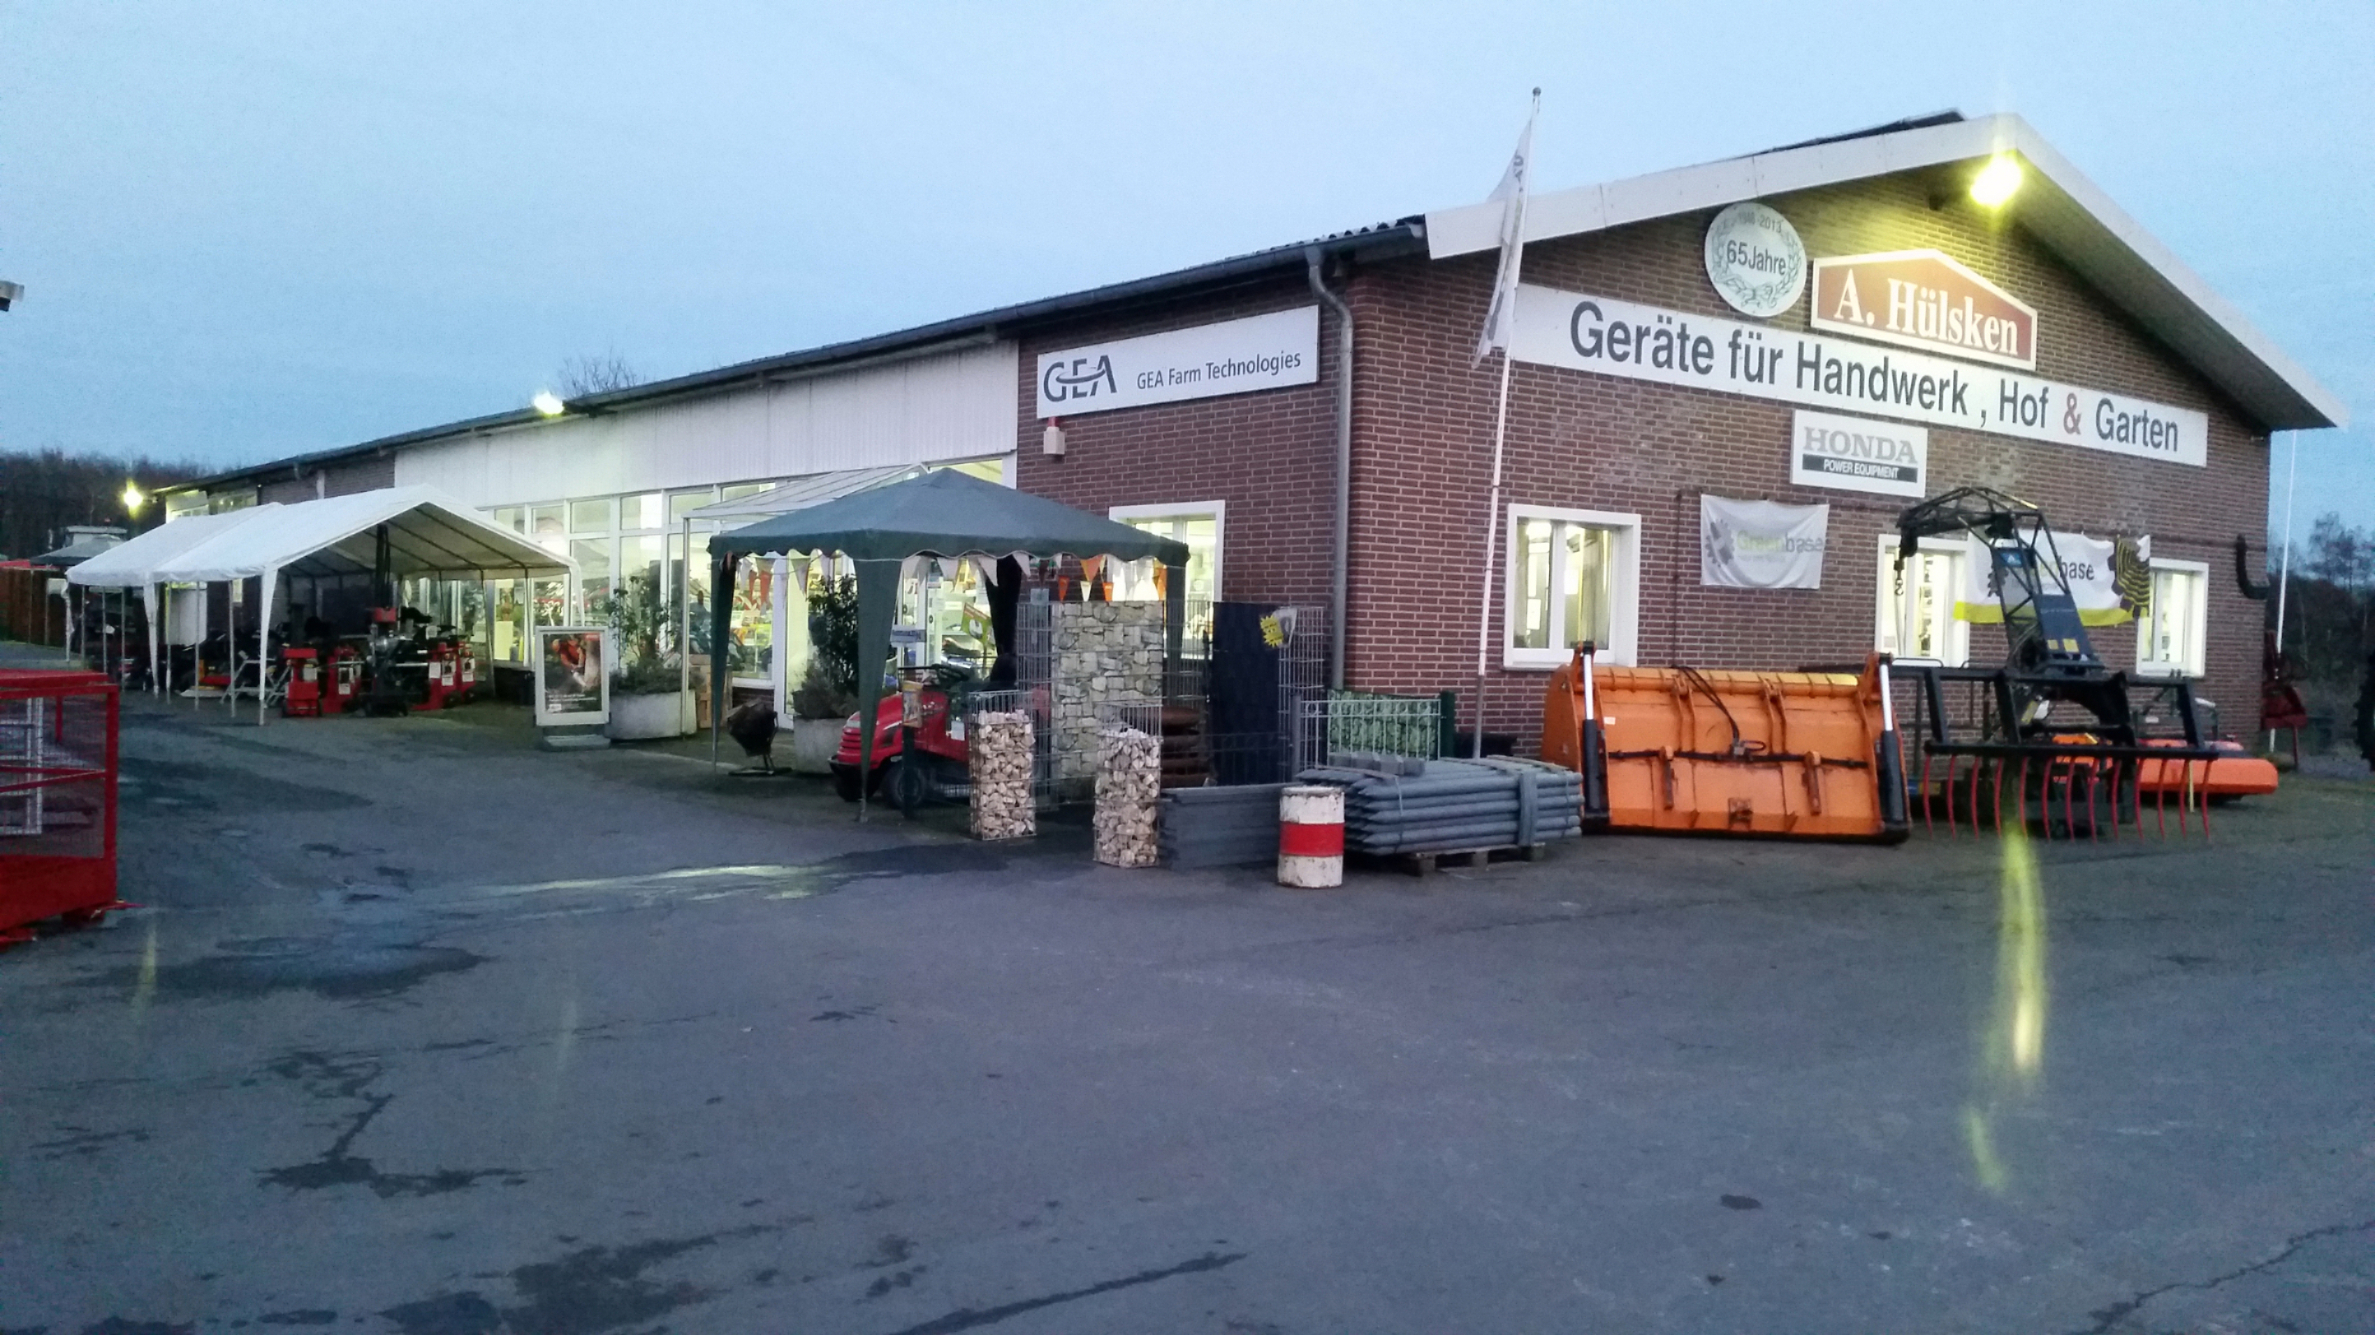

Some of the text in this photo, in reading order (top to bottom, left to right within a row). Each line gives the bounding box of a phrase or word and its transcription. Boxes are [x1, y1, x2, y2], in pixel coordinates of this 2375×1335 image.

[1834, 268, 2018, 356] A. Hülsken
[1043, 355, 1117, 402] GEA
[1137, 350, 1301, 389] GEA Farm Technologies
[1570, 300, 1715, 376] Geräte
[1728, 329, 1784, 385] für
[1796, 340, 1969, 416] Handwerk
[1999, 378, 2050, 428] Hof
[2063, 392, 2082, 435] &
[2095, 397, 2179, 452] Garten
[1803, 426, 1918, 464] HONDA
[1823, 459, 1900, 479] POWER EQUIPMENT
